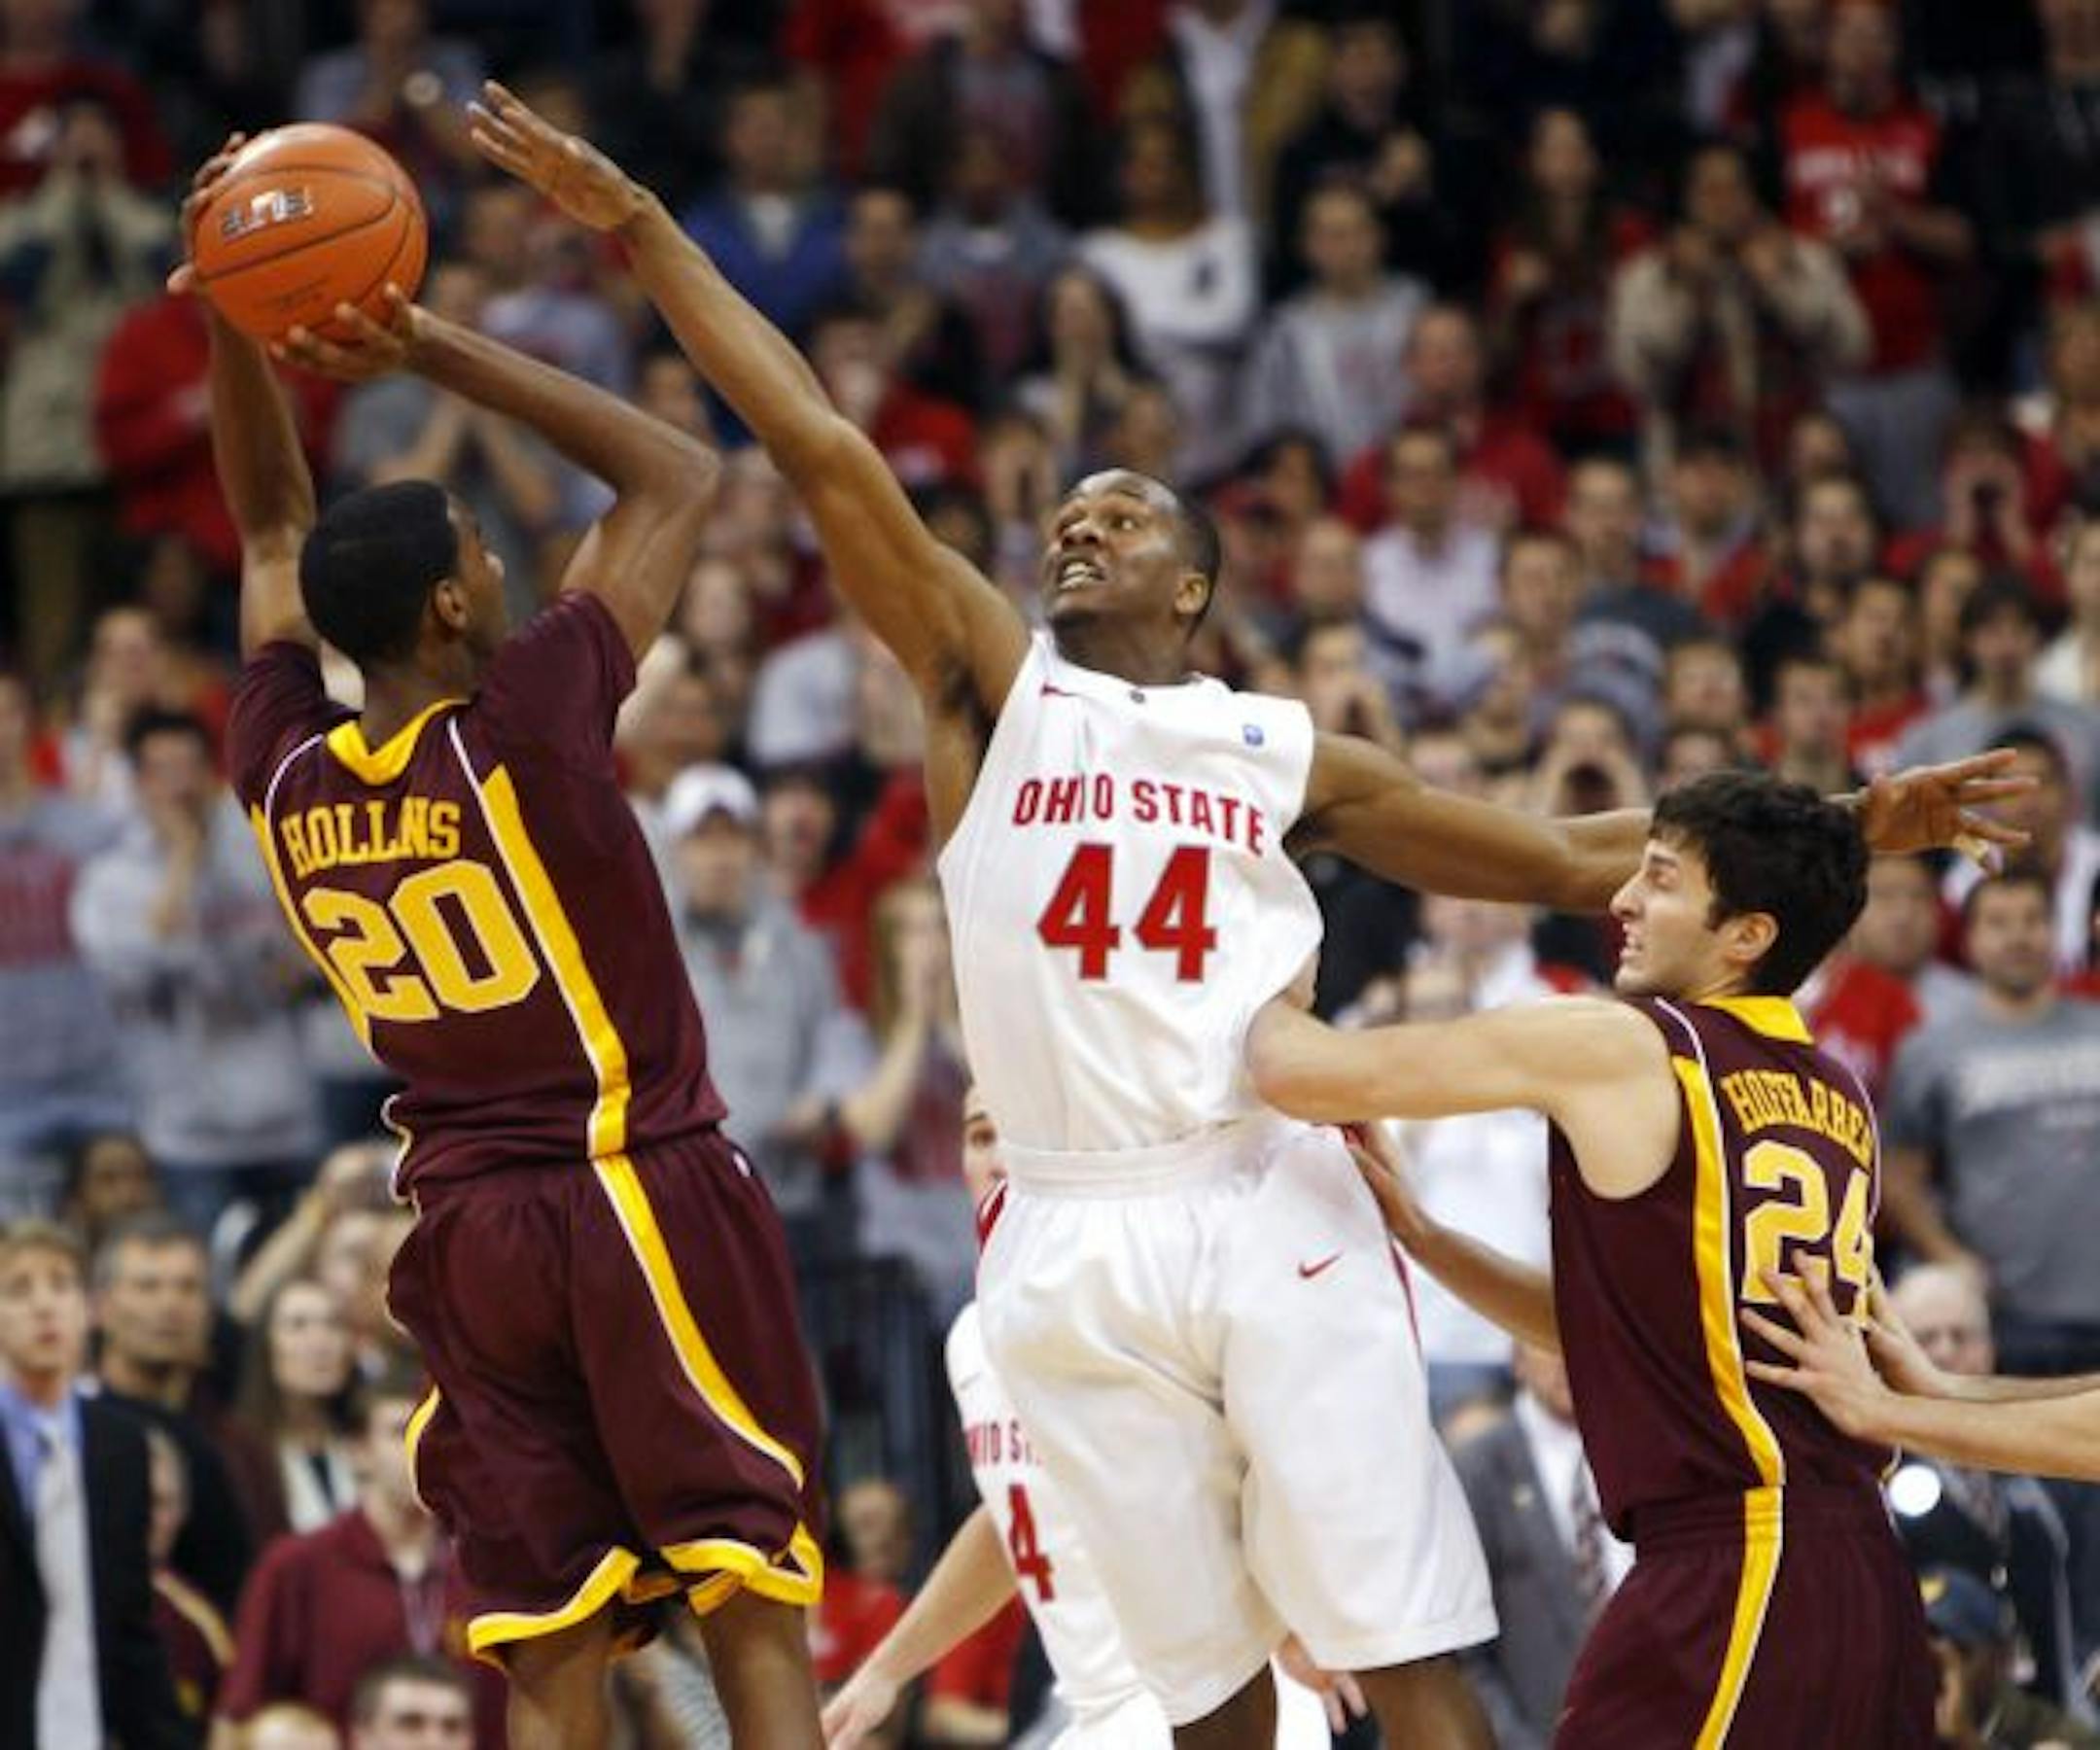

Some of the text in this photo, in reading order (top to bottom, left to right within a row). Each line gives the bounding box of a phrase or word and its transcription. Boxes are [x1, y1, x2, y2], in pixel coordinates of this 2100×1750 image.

[1012, 773, 1265, 858] OHIO STATE
[302, 859, 541, 1023] 20
[1036, 841, 1219, 983] 44
[1741, 1138, 1874, 1330] 24
[1007, 1483, 1056, 1602] 4
